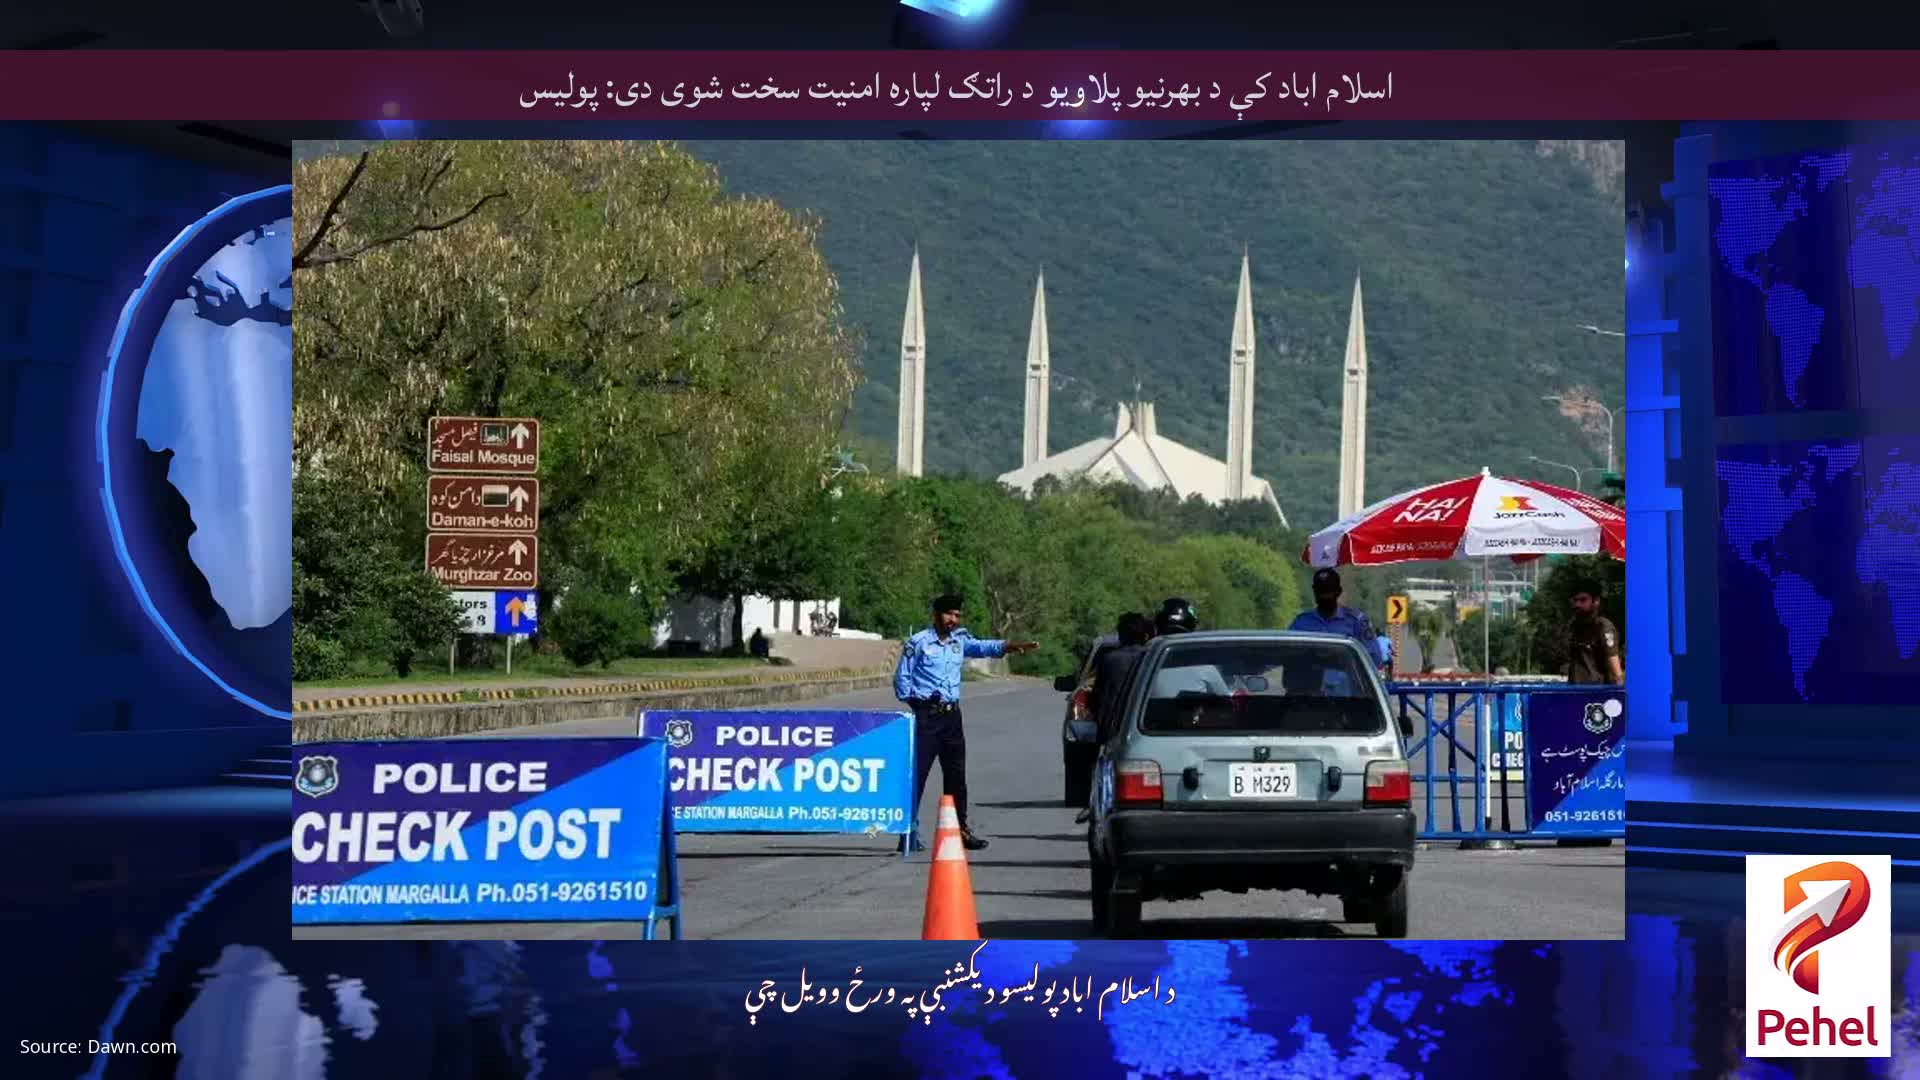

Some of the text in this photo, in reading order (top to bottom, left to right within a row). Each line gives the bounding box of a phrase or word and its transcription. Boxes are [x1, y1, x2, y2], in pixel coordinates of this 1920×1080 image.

[431, 449, 535, 467] Faisal Mosque
[431, 512, 534, 528] Daman-e-koh
[1392, 509, 1454, 523] NA!
[431, 566, 533, 584] Murghzar Zoo
[716, 726, 834, 746] POLICE
[373, 761, 548, 794] POLICE
[670, 757, 886, 793] CHECK POST
[684, 806, 726, 819] STATION
[728, 806, 784, 819] MARGALLA
[788, 807, 904, 821] Ph.051-9261510
[292, 808, 622, 863] CHECK POST
[320, 884, 382, 905] STATION
[386, 884, 469, 904] MARGALLA
[476, 881, 648, 903] Ph.051-9261510
